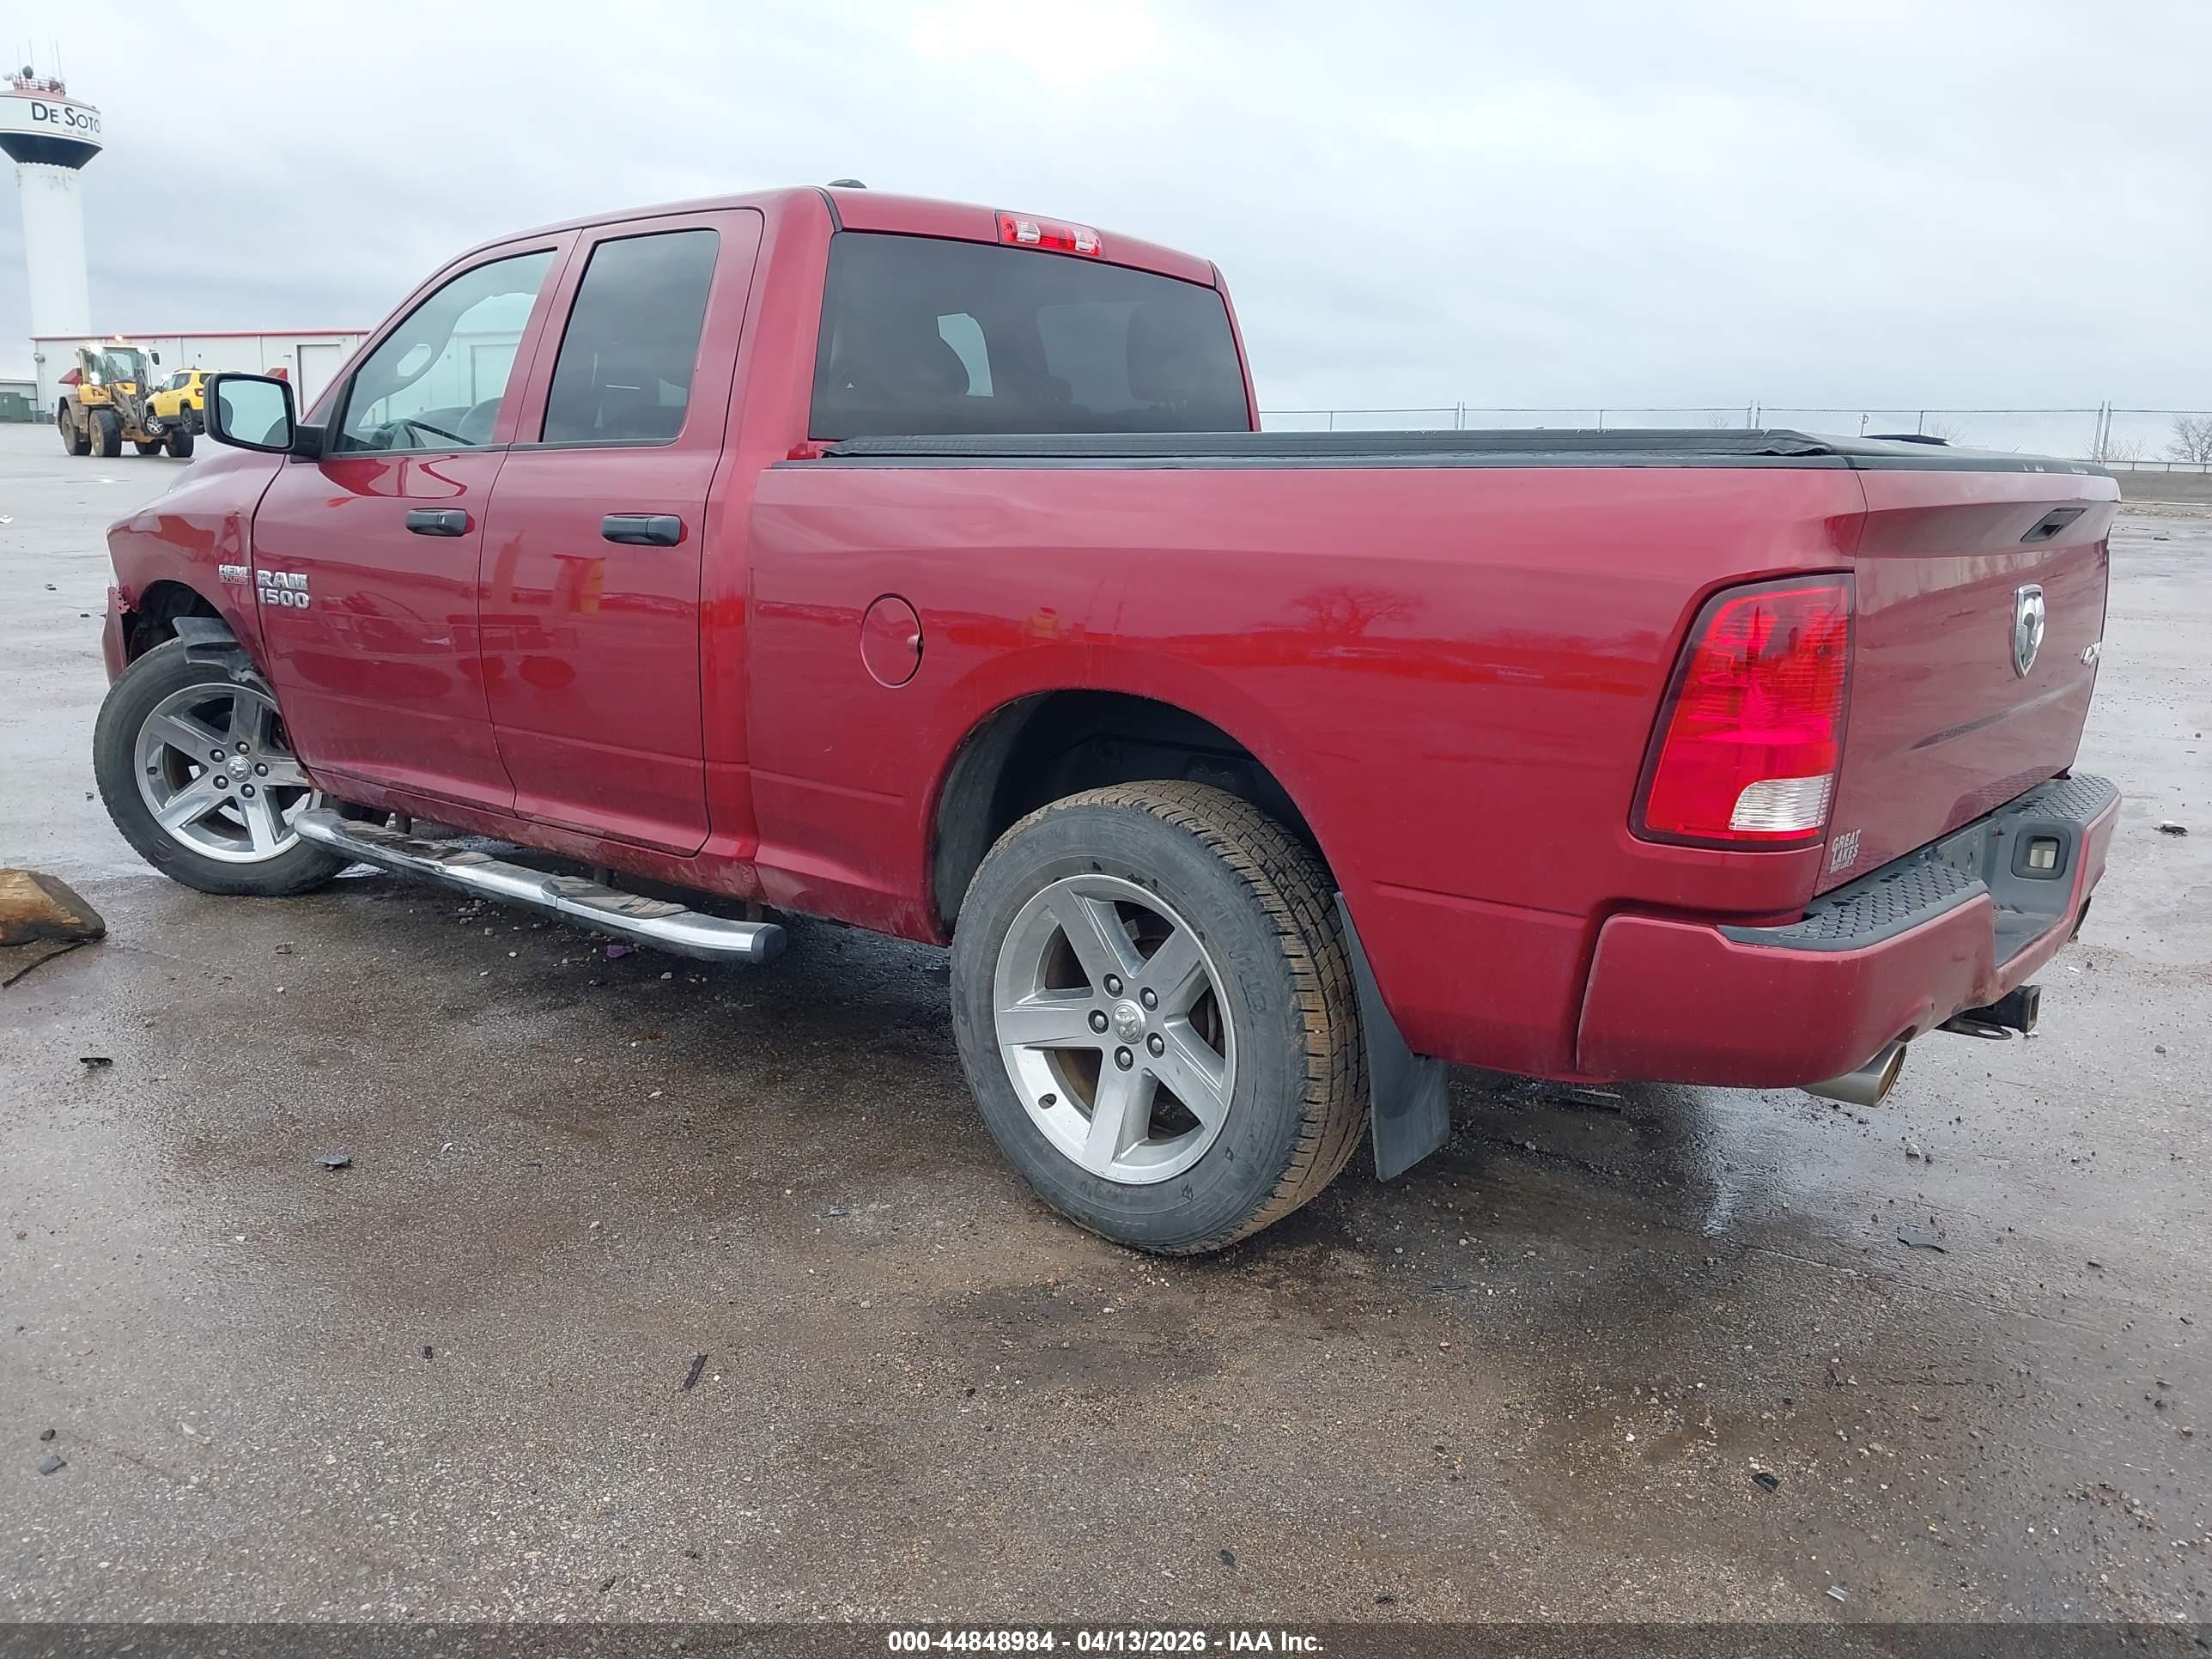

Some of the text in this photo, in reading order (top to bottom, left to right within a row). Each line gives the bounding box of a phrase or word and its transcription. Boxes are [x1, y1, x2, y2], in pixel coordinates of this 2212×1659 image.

[257, 569, 308, 591] RAM
[258, 587, 310, 610] 1500
[1832, 829, 1862, 853] GREAT
[1831, 843, 1860, 867] LAKES
